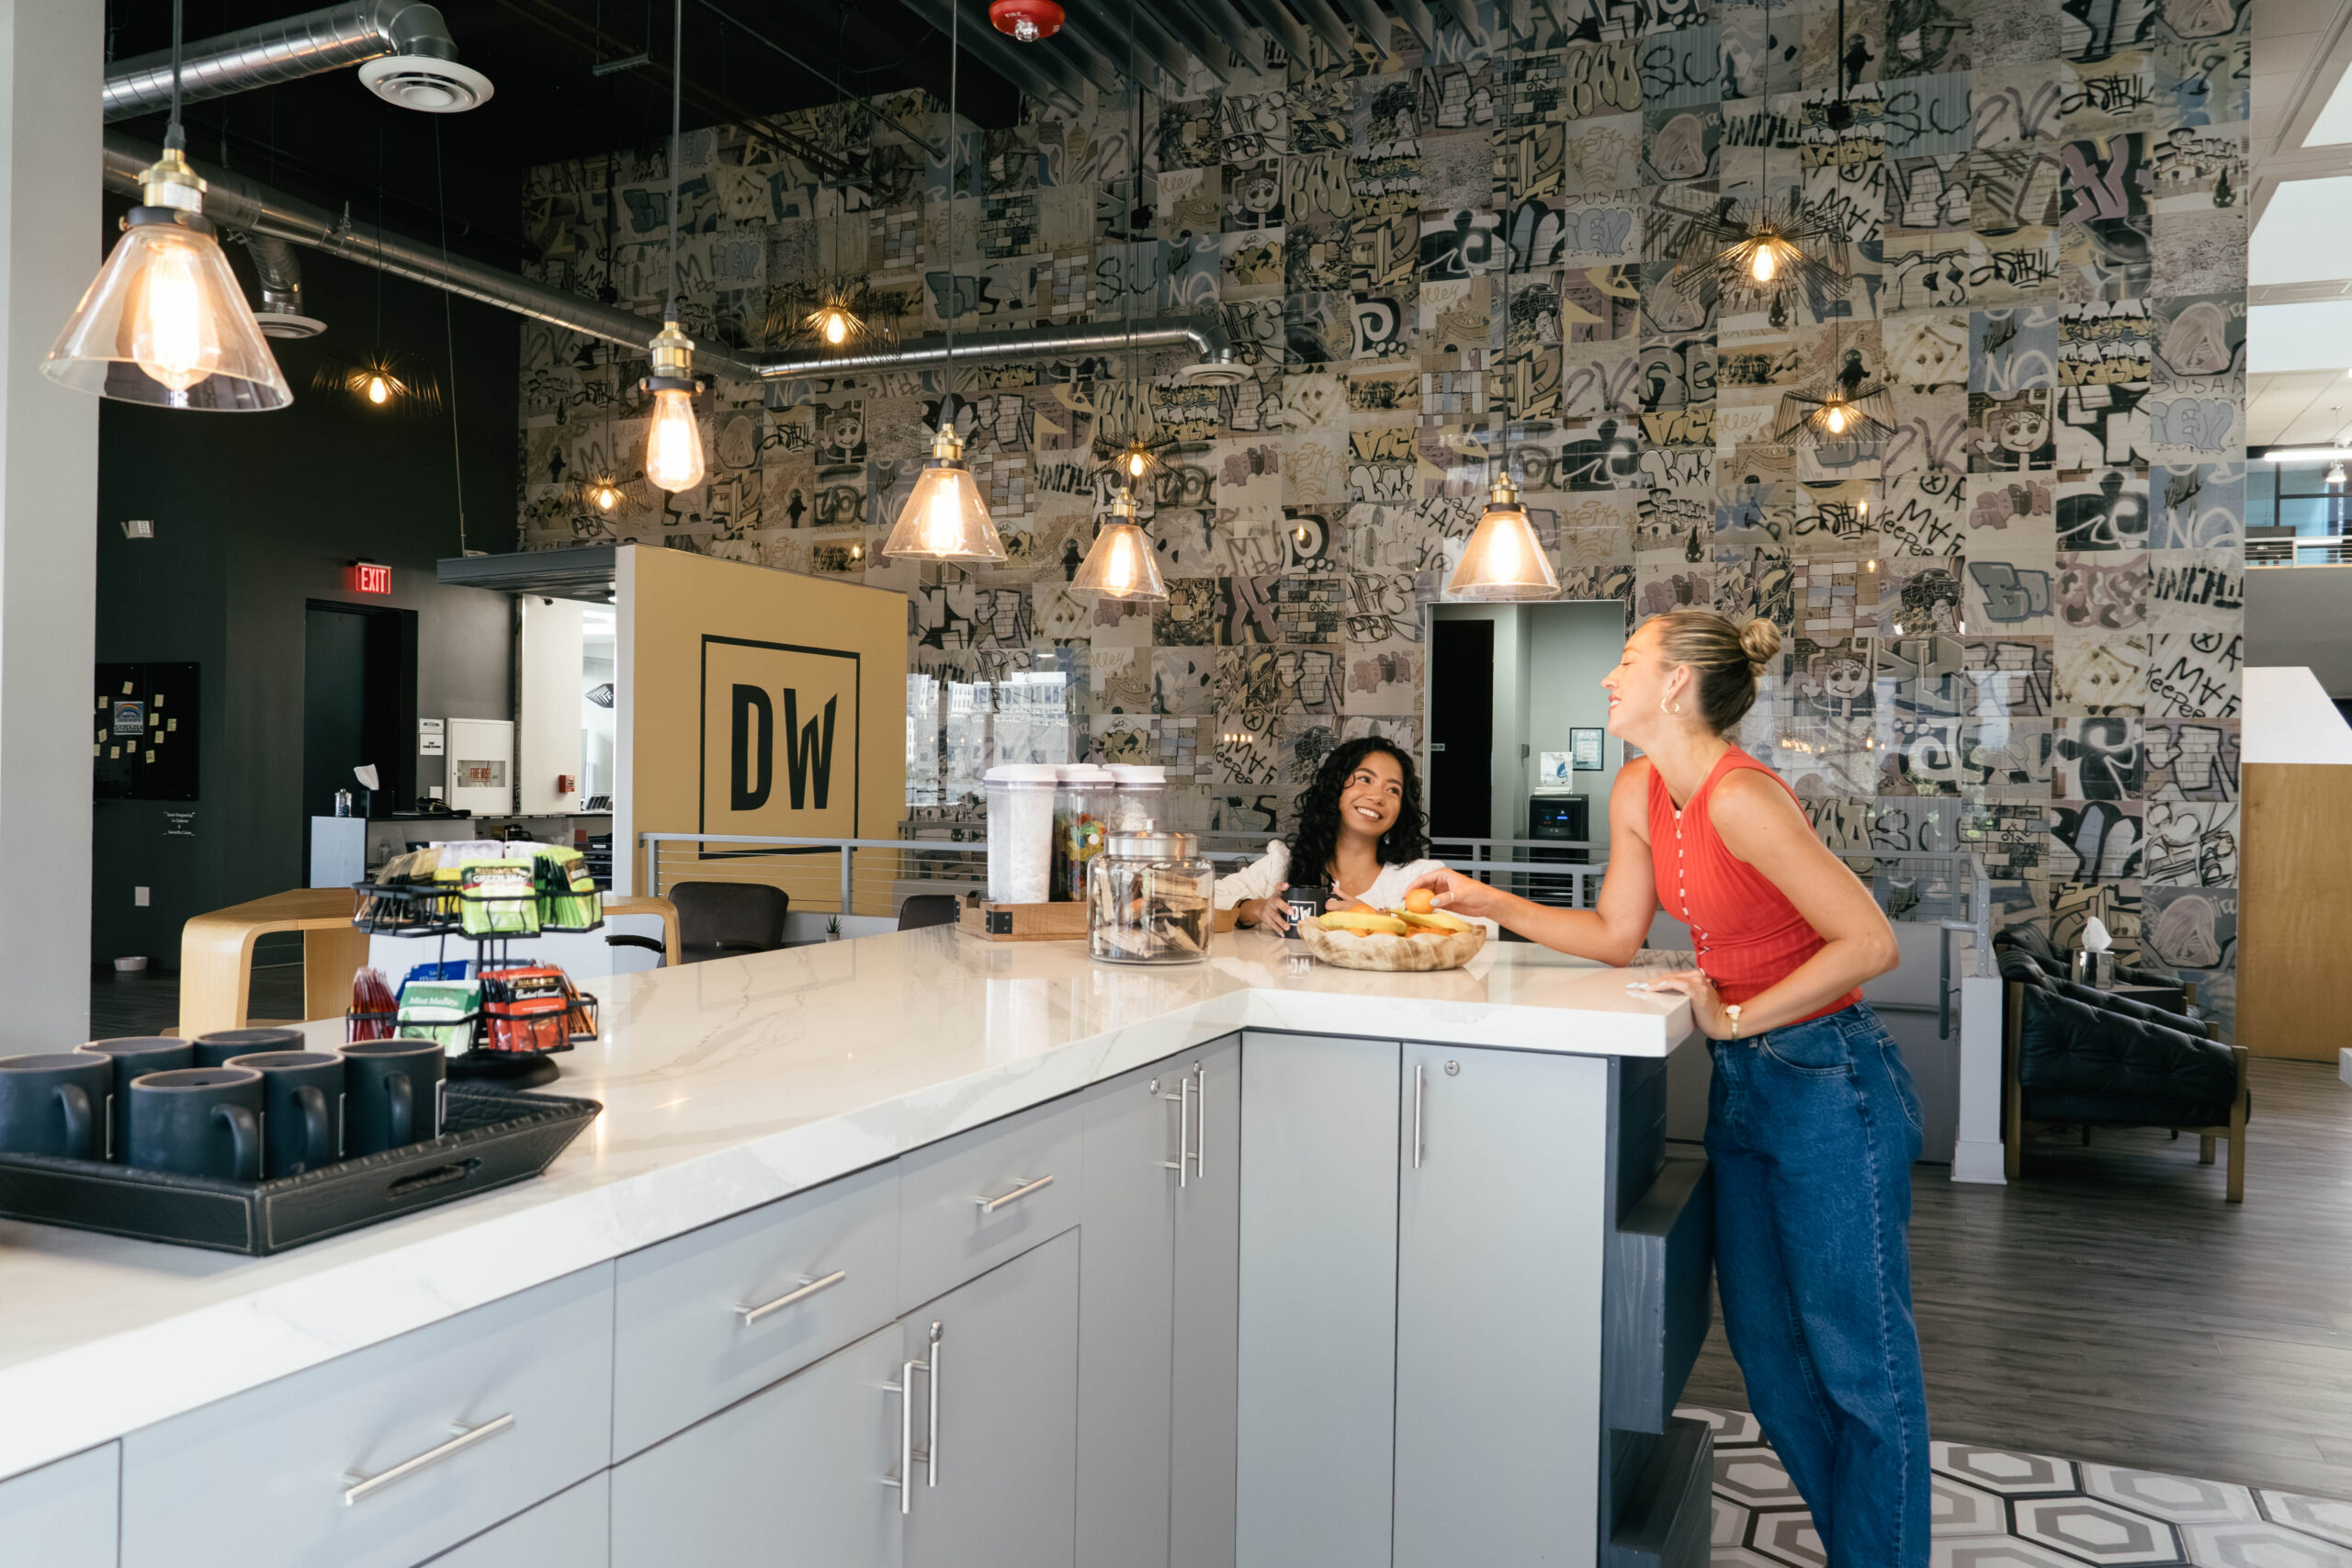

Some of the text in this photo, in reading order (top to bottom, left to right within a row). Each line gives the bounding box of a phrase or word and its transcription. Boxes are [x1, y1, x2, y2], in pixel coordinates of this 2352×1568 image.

[361, 567, 387, 592] EXIT
[730, 682, 838, 811] DW
[1290, 905, 1312, 921] DW
